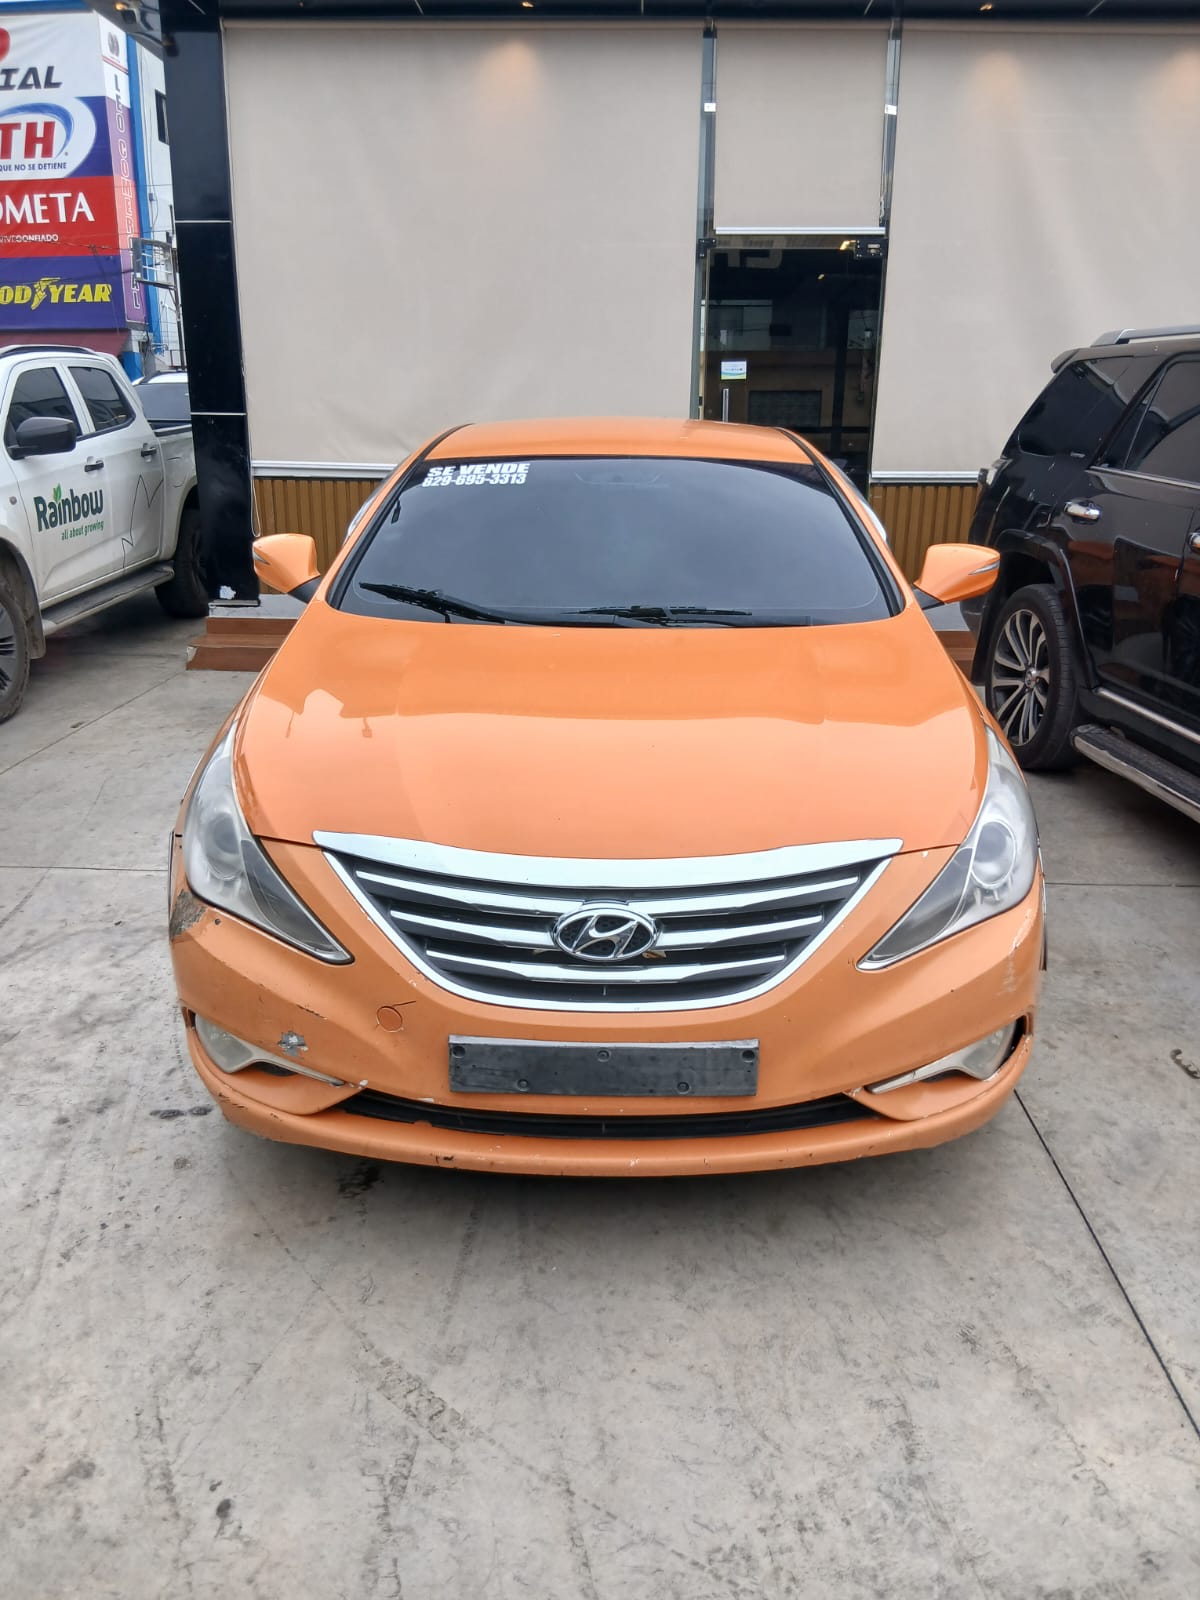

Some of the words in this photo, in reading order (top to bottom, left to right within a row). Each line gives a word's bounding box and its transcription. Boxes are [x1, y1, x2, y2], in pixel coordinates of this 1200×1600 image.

[28, 163, 35, 171] SE
[38, 162, 67, 171] DETIENE
[0, 192, 95, 224] META
[427, 466, 456, 477] SE
[460, 463, 531, 475] VENDE
[422, 473, 527, 487] 829-695-3313
[33, 488, 104, 532] Rainbow
[61, 532, 69, 541] all
[69, 527, 84, 538] about
[84, 521, 104, 536] growing
